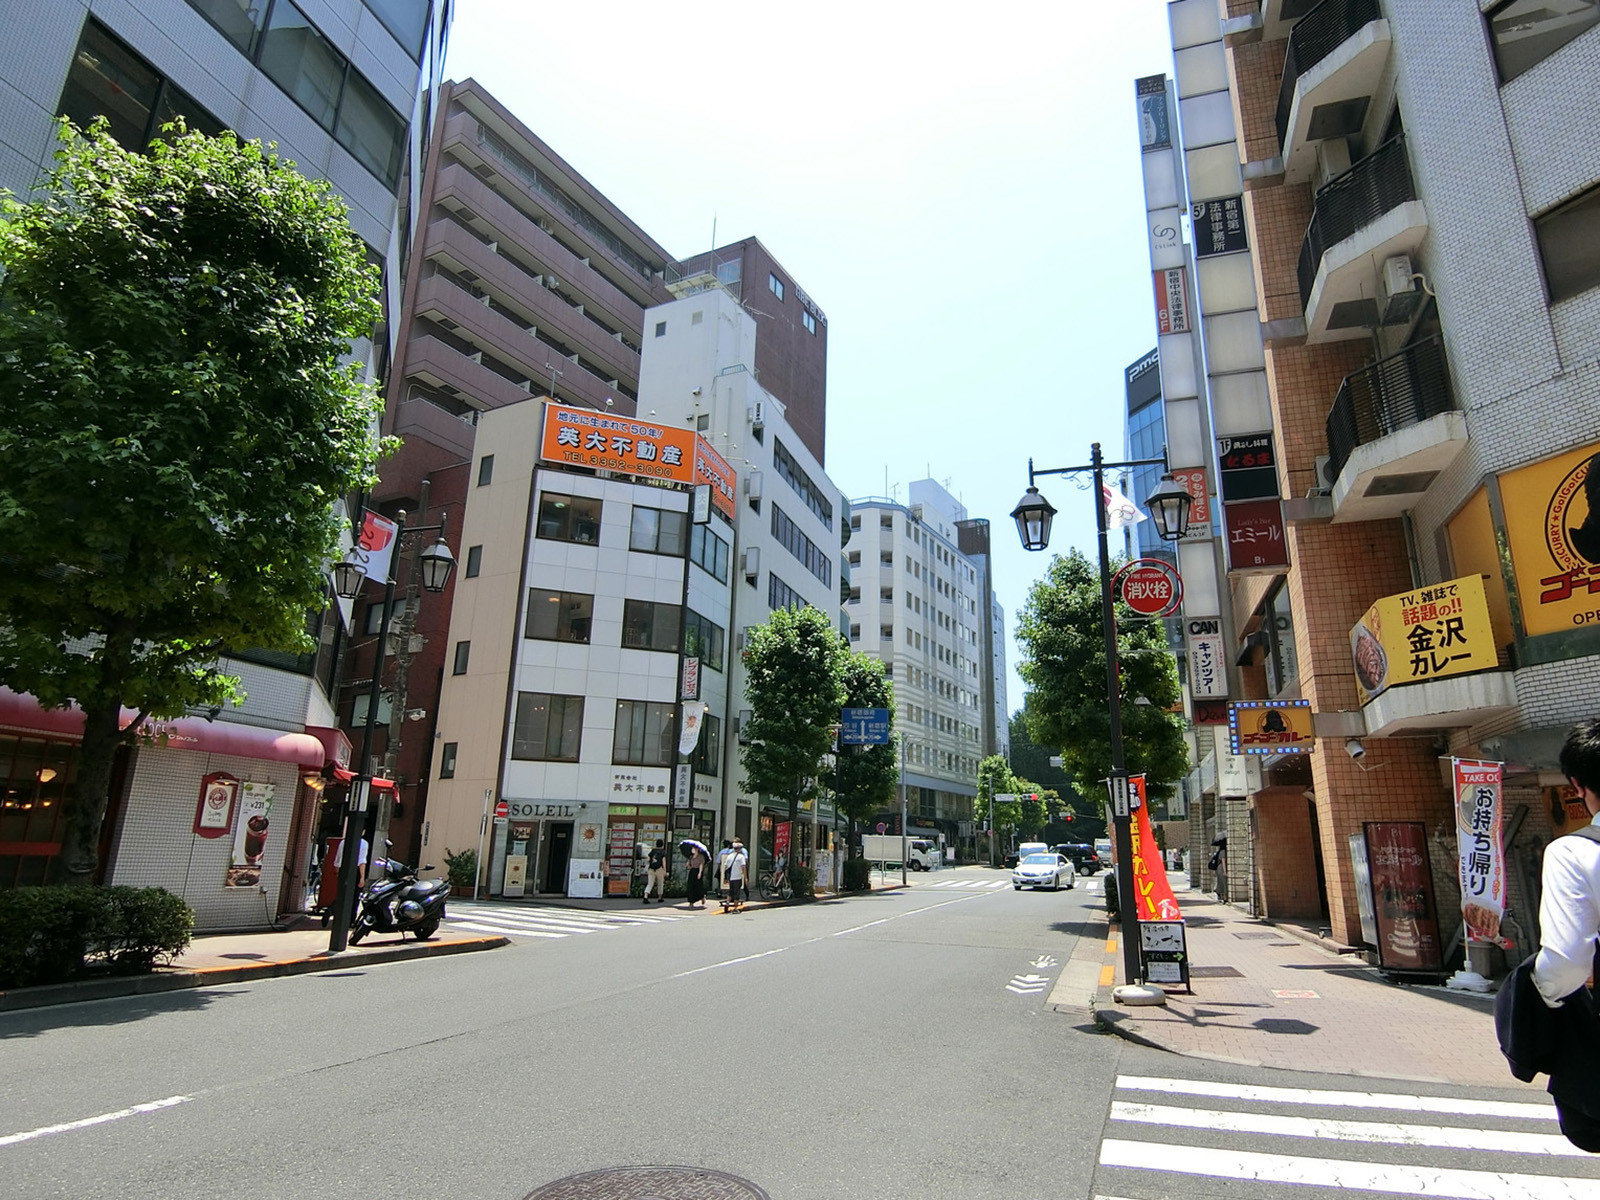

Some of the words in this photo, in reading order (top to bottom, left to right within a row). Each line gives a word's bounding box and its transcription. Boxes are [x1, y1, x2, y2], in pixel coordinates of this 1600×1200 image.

[1209, 202, 1226, 252] 法律事務所
[1225, 200, 1240, 235] 新宿第一
[1158, 309, 1169, 331] 6F
[557, 426, 683, 467] 英大不動産
[563, 451, 587, 463] TEL
[590, 457, 673, 477] 3352-3090
[1231, 525, 1281, 543] エミール
[1127, 581, 1169, 599] 消火栓
[1400, 584, 1459, 607] TV、雑誌で
[1188, 620, 1219, 635] CAN
[1406, 616, 1468, 654] 金沢
[1198, 642, 1213, 694] キャンツアー
[1410, 652, 1472, 677] カレー
[1463, 773, 1485, 782] TAKE
[511, 804, 574, 817] SOLEIL
[1468, 788, 1494, 896] お持ち帰り
